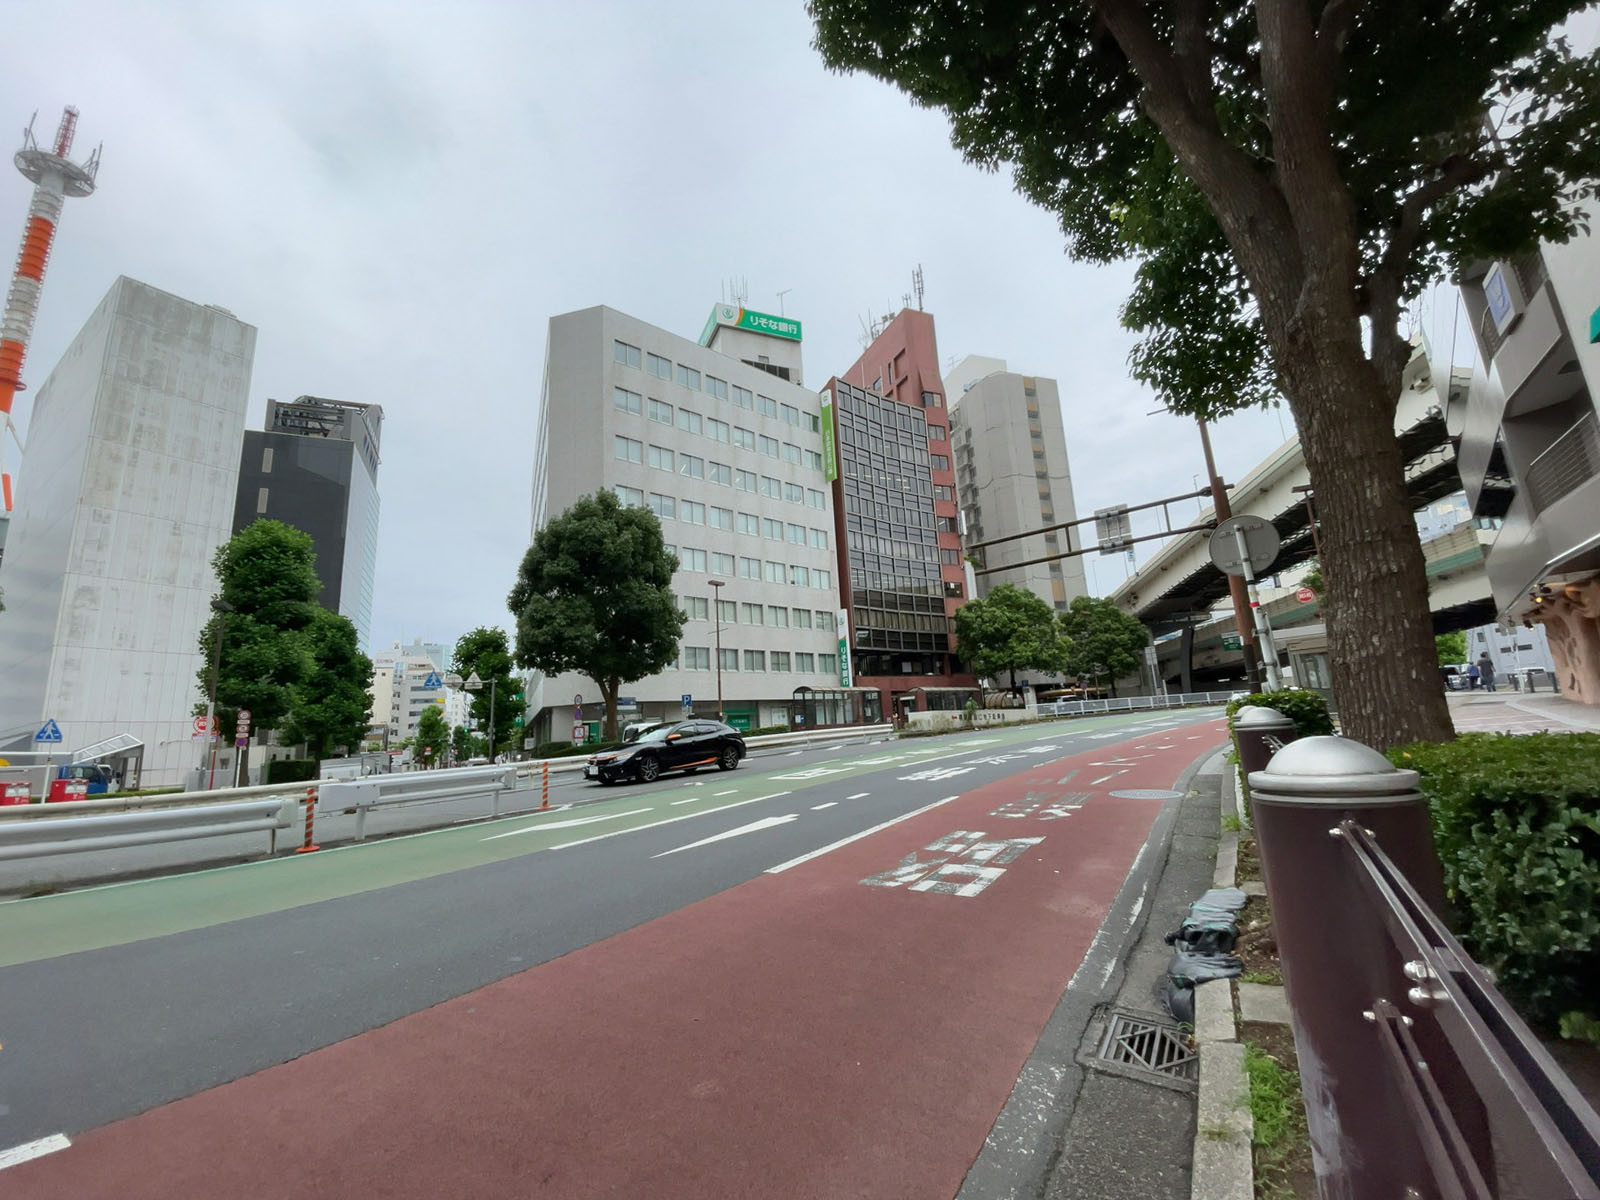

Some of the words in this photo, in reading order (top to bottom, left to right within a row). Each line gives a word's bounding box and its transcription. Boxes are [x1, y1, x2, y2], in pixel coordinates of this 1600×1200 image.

[749, 315, 797, 334] りそな銀行
